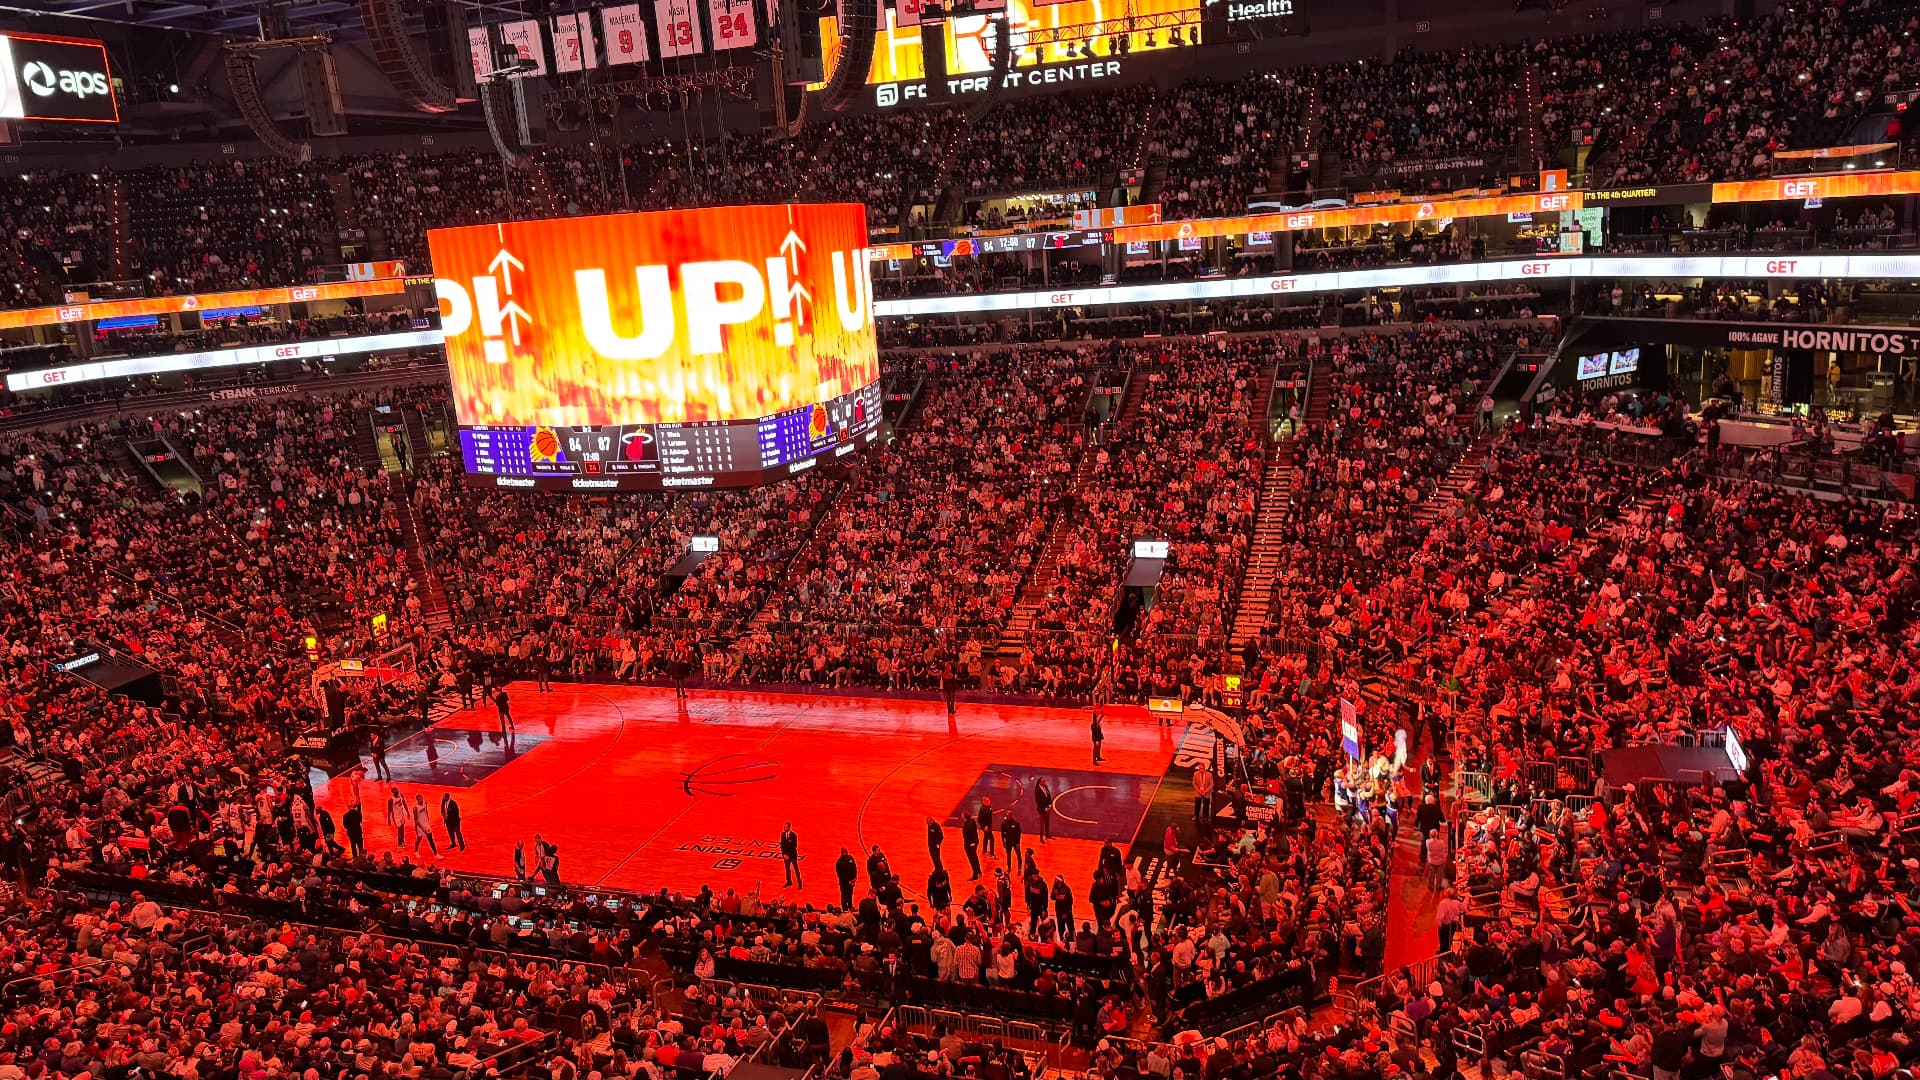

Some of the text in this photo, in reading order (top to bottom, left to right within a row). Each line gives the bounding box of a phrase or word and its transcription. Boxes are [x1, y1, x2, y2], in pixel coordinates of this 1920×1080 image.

[669, 7, 685, 16] NASH
[718, 12, 749, 38] 24
[511, 30, 529, 40] DAVIS
[667, 22, 691, 46] 13
[618, 29, 634, 54] 9
[566, 38, 579, 61] 7
[1028, 61, 1121, 85] CENTER
[59, 70, 108, 99] aps
[1597, 191, 1610, 200] THE
[1622, 188, 1656, 198] QUARTER!
[1784, 182, 1816, 196] GET
[1541, 195, 1568, 208] GET
[1288, 215, 1315, 227] GET
[984, 241, 993, 252] 84
[1000, 237, 1018, 247] 12:00
[1027, 238, 1035, 248] 87
[1521, 263, 1550, 275] GET
[1766, 261, 1797, 273] GET
[1271, 279, 1297, 290] GET
[293, 288, 318, 300] GET
[1051, 293, 1075, 304] GET
[60, 307, 84, 320] GET
[574, 256, 796, 359] UP!
[1728, 331, 1750, 342] 100%
[1751, 332, 1779, 343] AGAVE
[1783, 330, 1905, 354] HORNITOS
[275, 346, 300, 357] GET
[43, 370, 66, 383] GET
[1582, 373, 1632, 391] HORNITOS
[259, 384, 299, 395] TERRACE
[569, 437, 582, 451] 84
[582, 452, 600, 461] 12:00
[572, 478, 619, 488] ticketmaster
[662, 476, 715, 487] ticketmaster
[700, 835, 782, 849] ENTER
